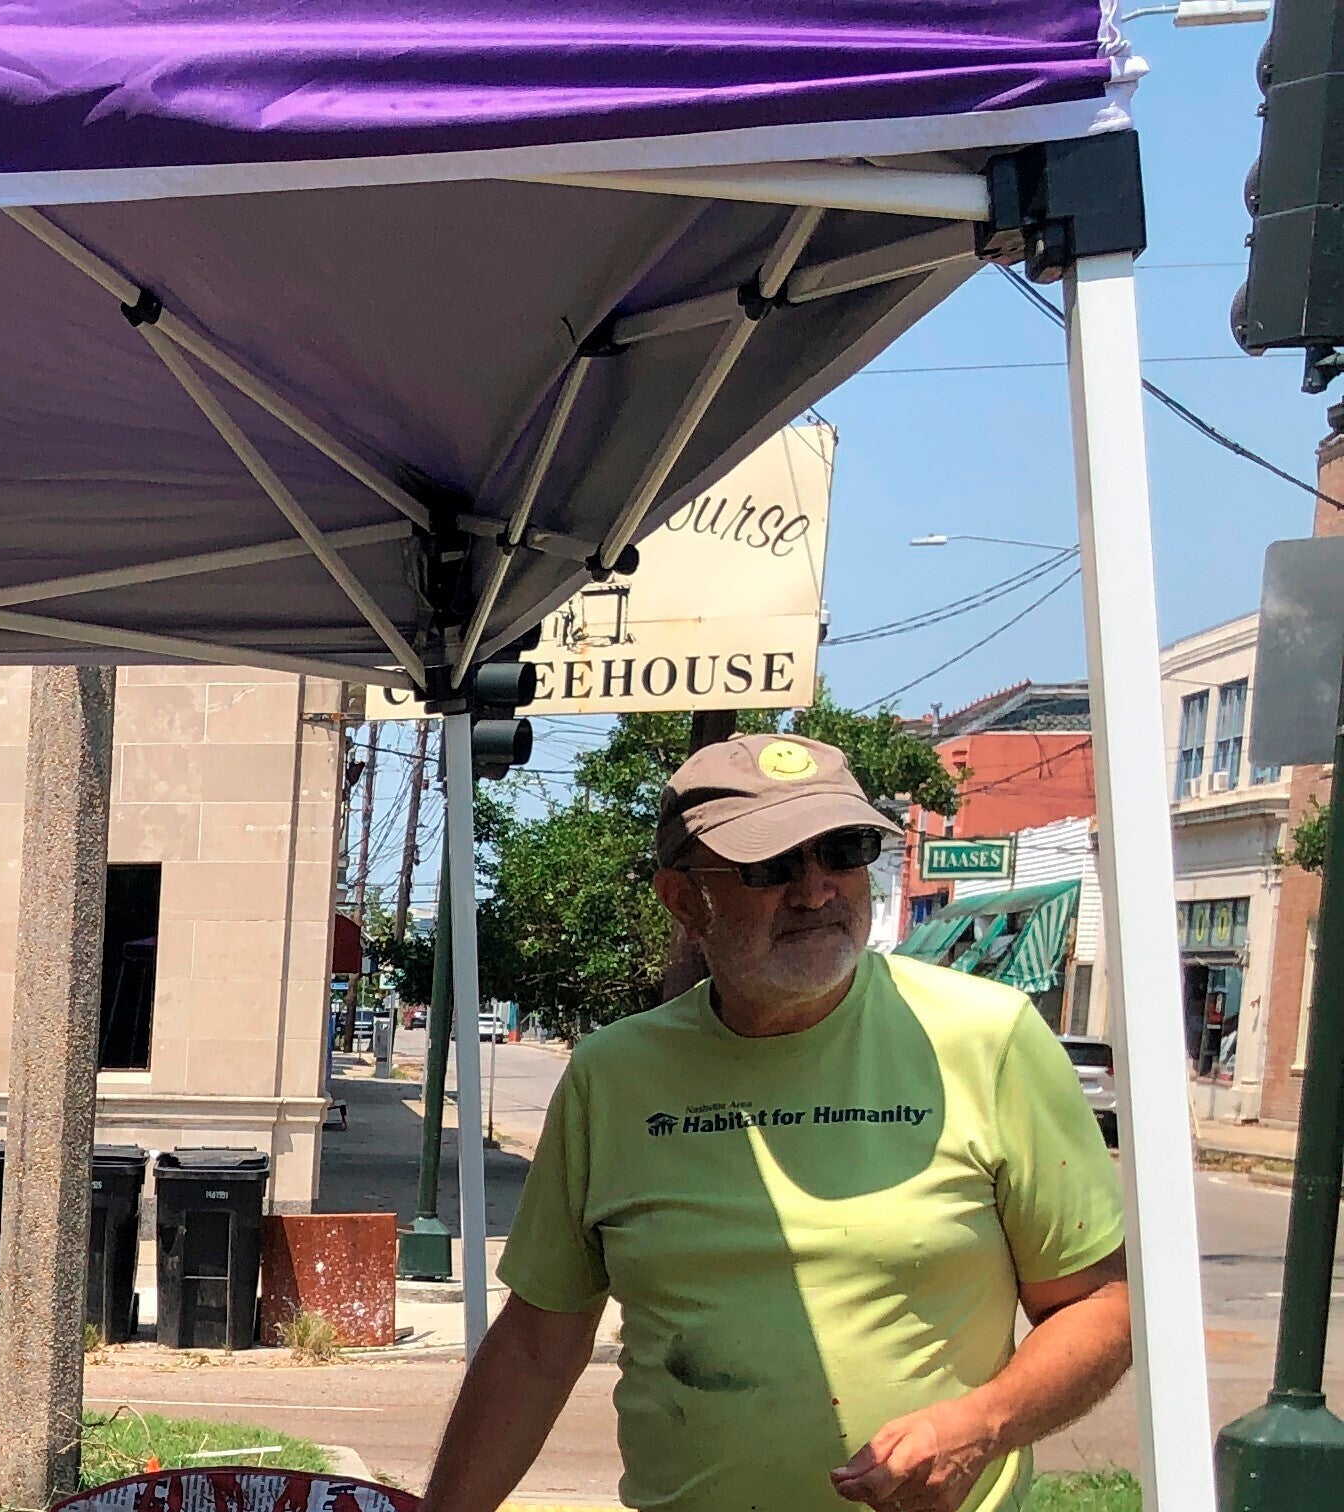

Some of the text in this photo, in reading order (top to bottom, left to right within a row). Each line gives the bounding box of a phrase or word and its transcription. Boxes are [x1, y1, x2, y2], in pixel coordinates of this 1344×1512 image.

[932, 849, 1001, 869] HAASES
[682, 1105, 926, 1134] Habitat for Humanity
